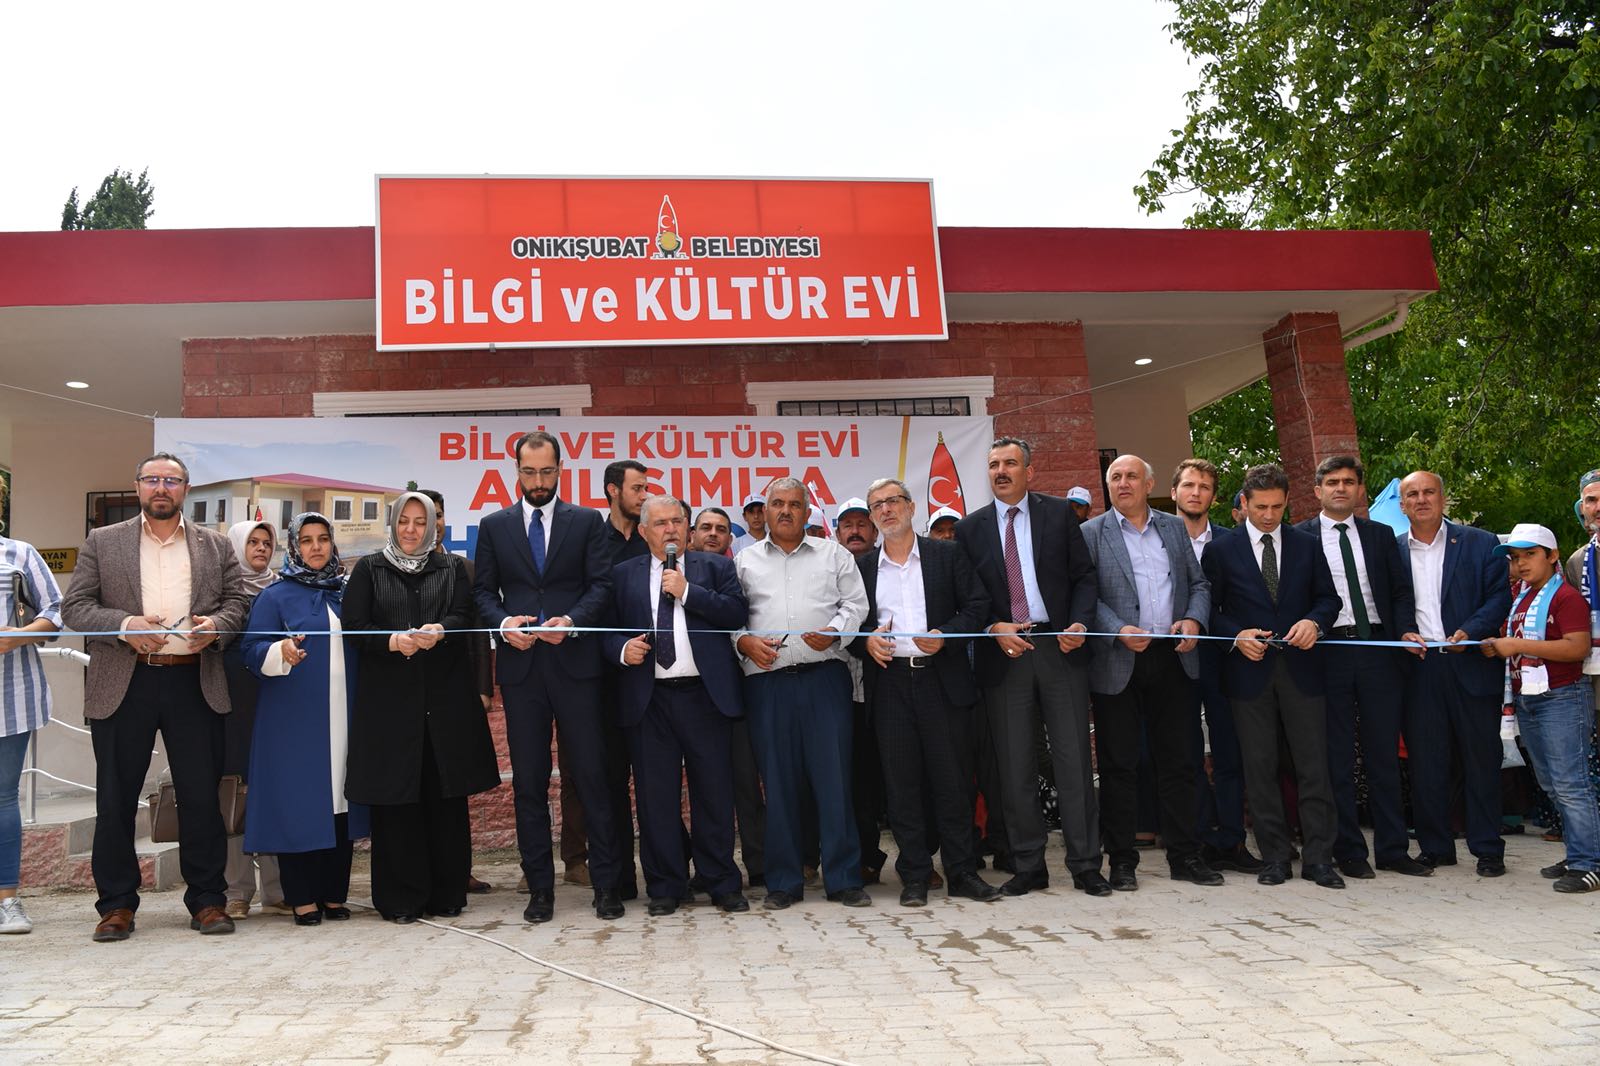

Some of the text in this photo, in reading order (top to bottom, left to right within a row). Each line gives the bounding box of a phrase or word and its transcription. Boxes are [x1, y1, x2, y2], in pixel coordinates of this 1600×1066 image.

[405, 266, 920, 325] BİLGİ ve KÜLTÜR EVİ
[560, 431, 616, 459] VE
[629, 425, 786, 459] KÜLTÜR
[797, 424, 860, 458] EVİ
[40, 551, 67, 560] AYAN
